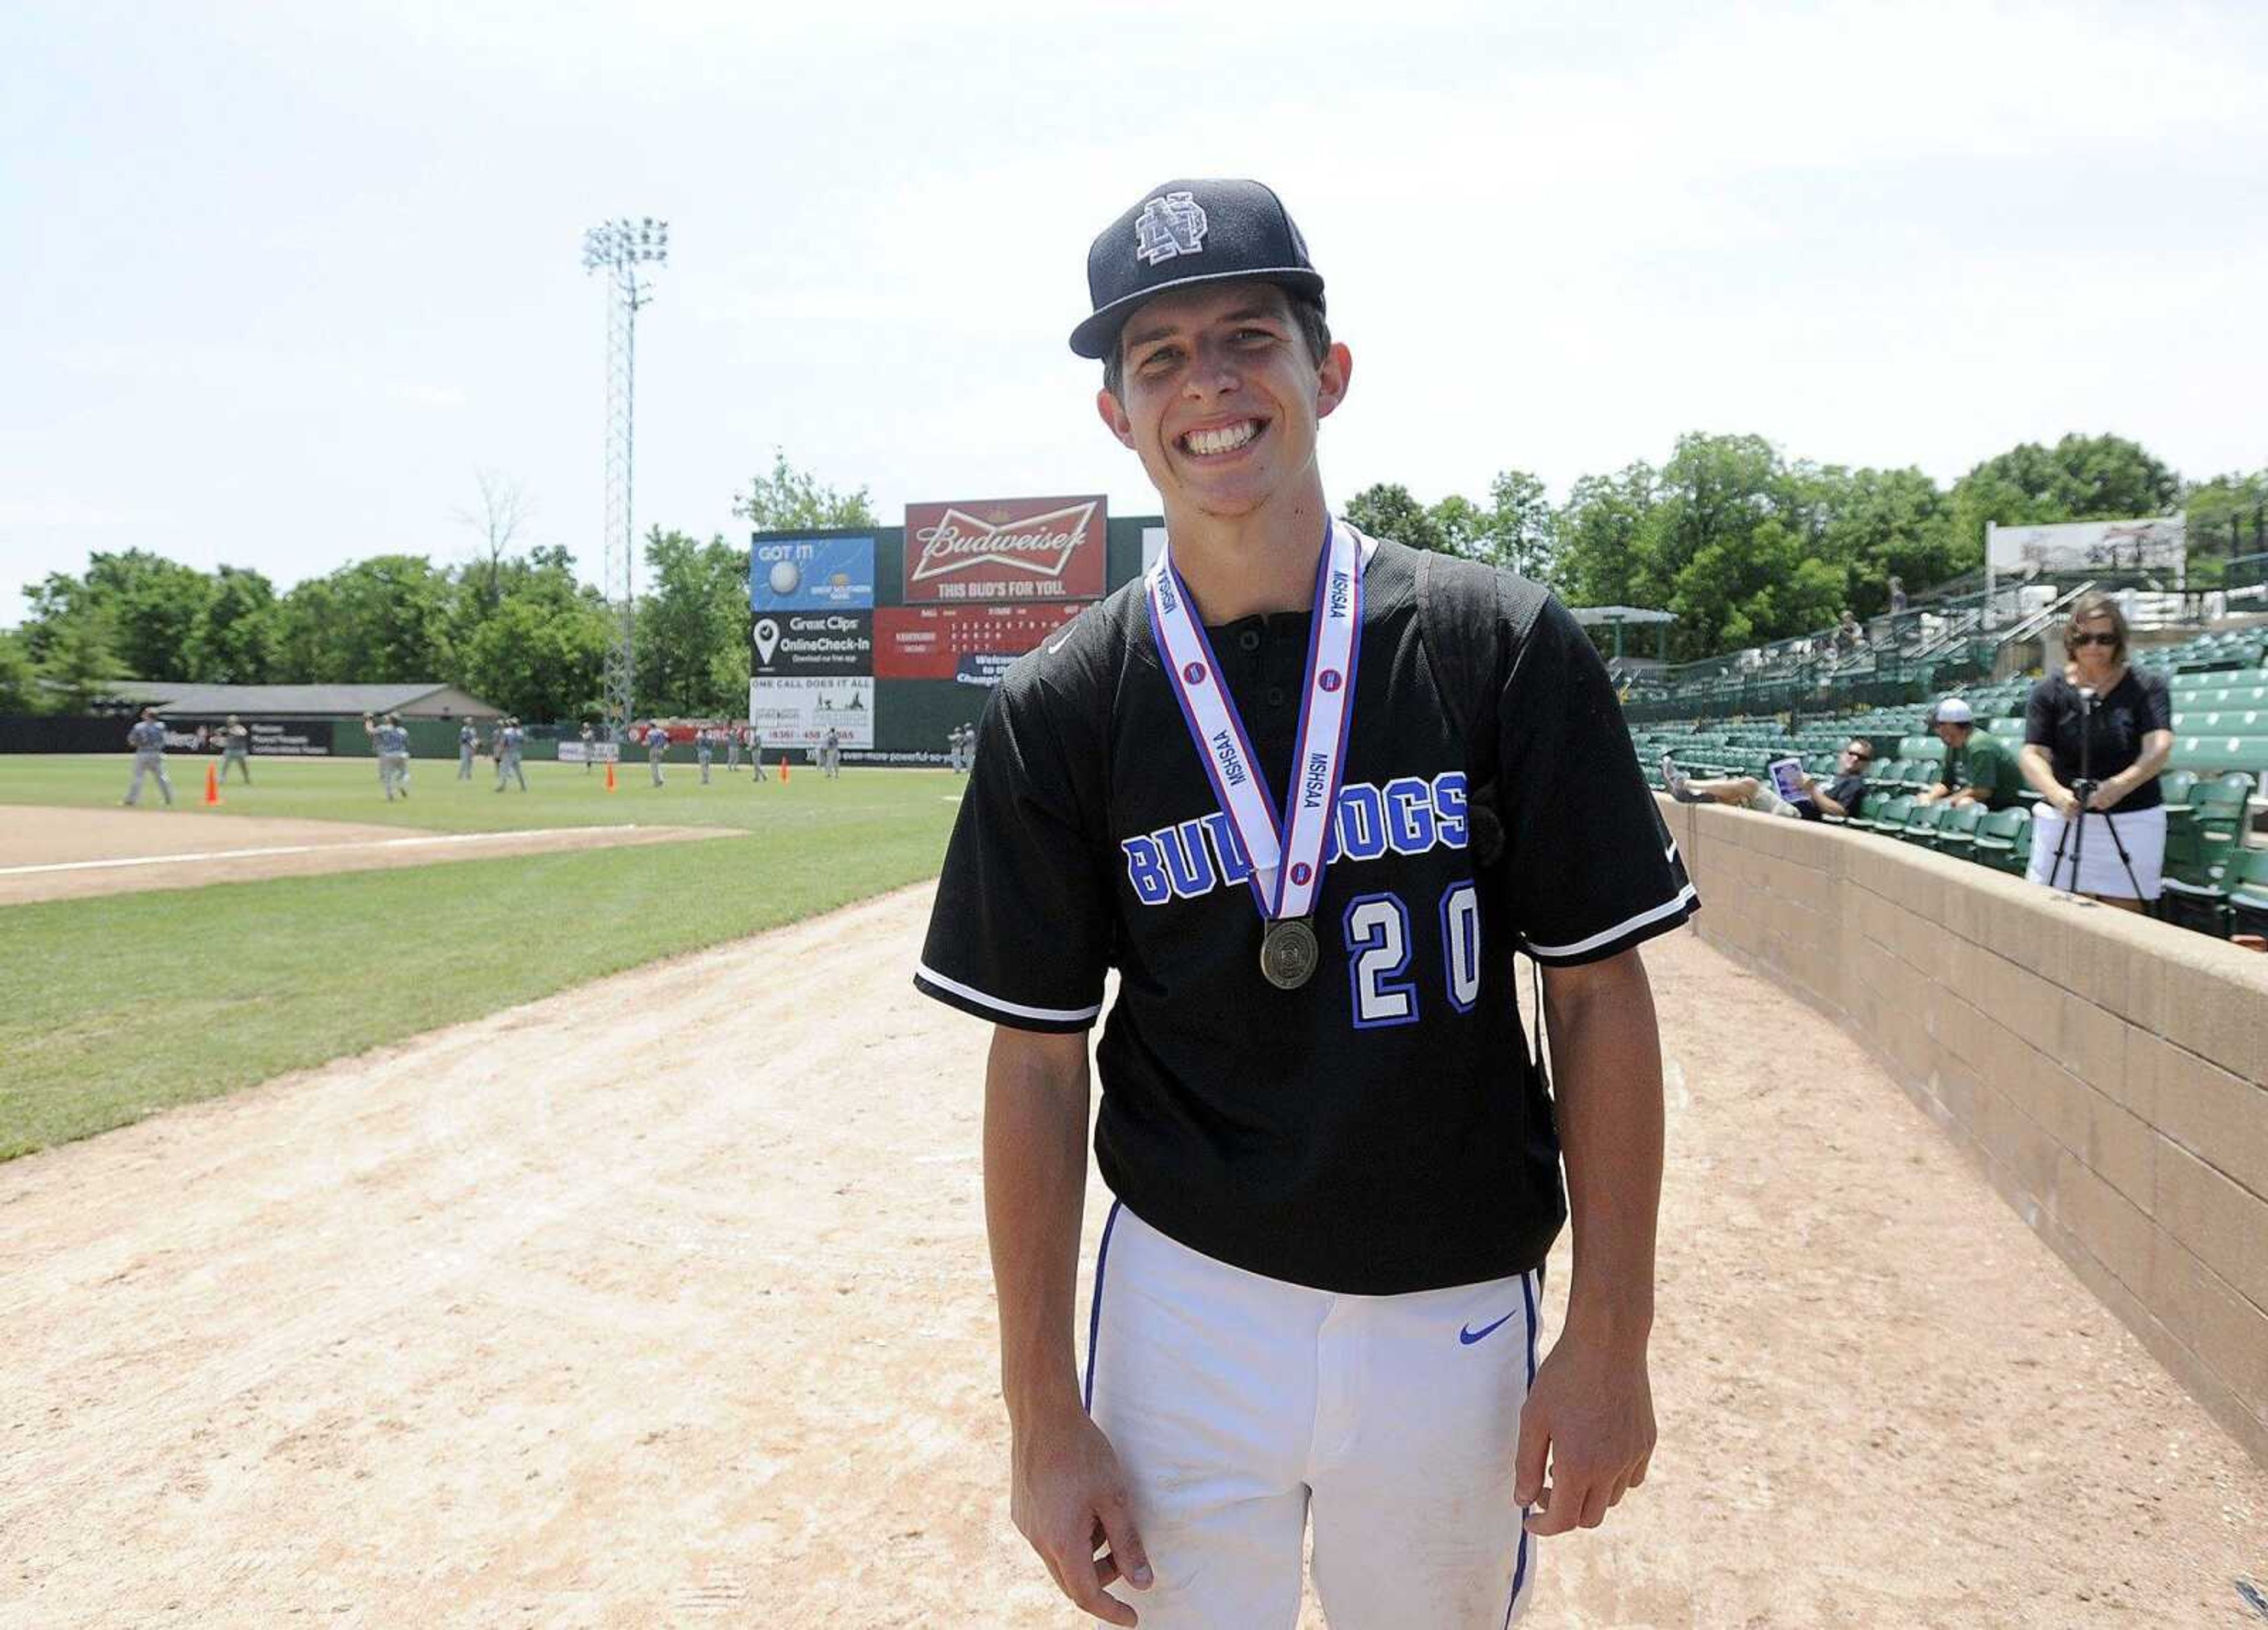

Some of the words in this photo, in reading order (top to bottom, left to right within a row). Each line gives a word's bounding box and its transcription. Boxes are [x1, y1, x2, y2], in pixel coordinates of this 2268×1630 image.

[758, 545, 794, 560] GOT
[917, 526, 1085, 558] Budweiser
[938, 583, 966, 598] THIS
[968, 582, 1004, 597] BUD'S
[1008, 582, 1032, 596] FOR
[1330, 570, 1348, 618] MSHSAA
[1213, 729, 1246, 786] MSHSAA
[1304, 752, 1328, 808] MSHSAA
[1122, 771, 1468, 905] BULOGS
[1341, 879, 1480, 1029] 20
